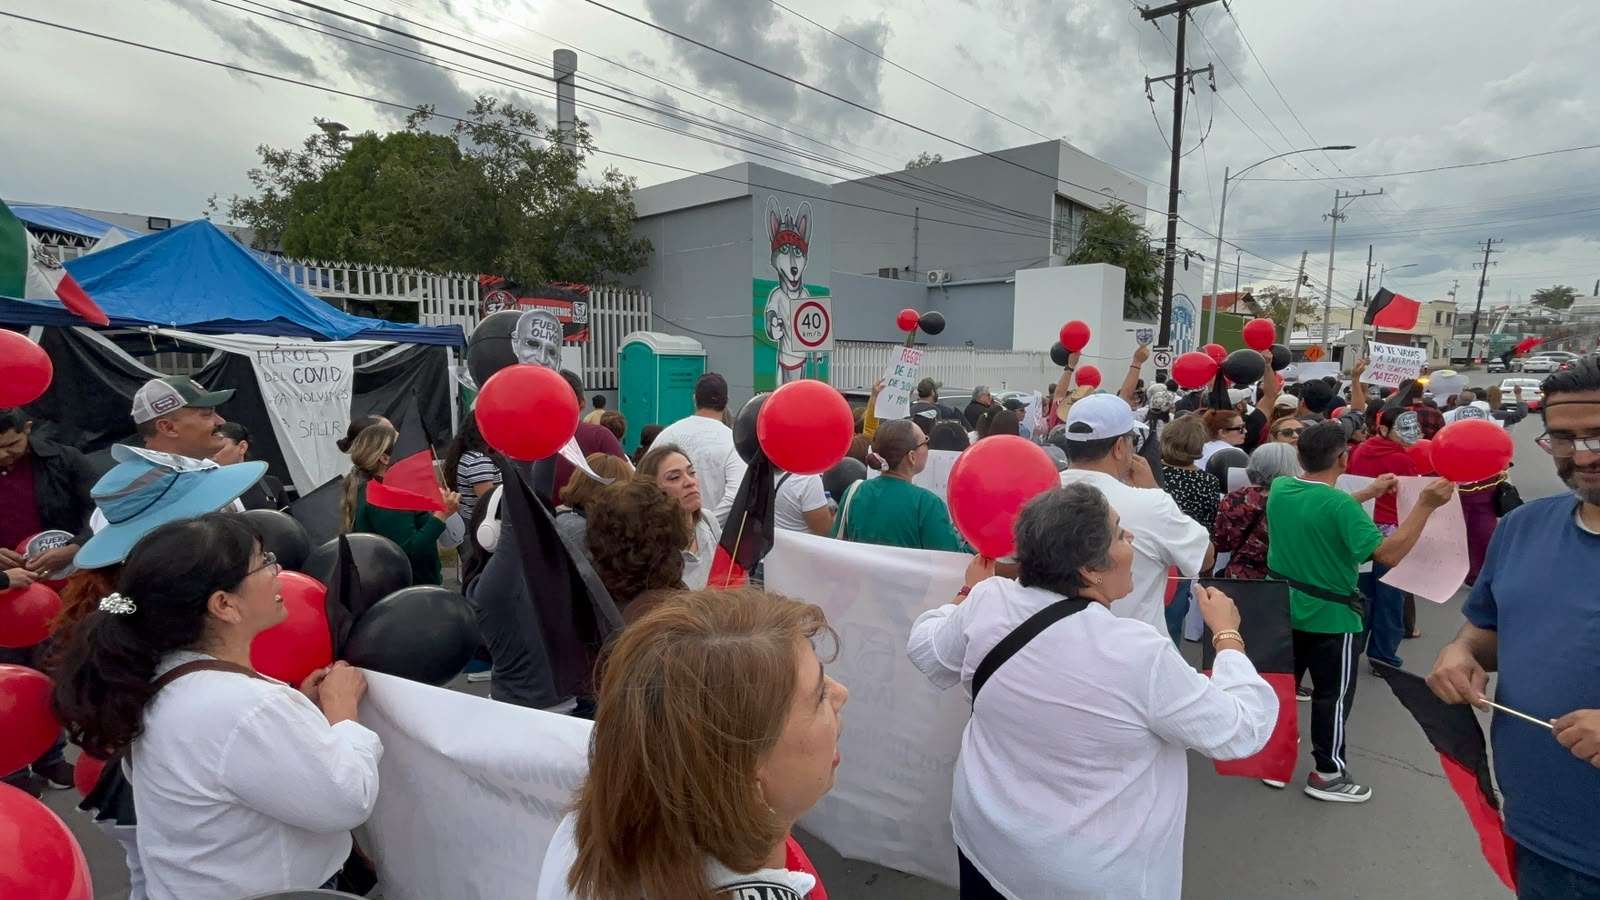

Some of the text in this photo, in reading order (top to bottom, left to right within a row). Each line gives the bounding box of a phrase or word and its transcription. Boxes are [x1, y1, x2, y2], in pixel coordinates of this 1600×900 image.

[801, 313, 821, 329] 40
[802, 329, 822, 337] km/h
[1373, 344, 1421, 360] NO TE VAYAS
[1373, 362, 1384, 370] NO
[293, 366, 341, 384] COVID
[299, 420, 342, 438] SALIR
